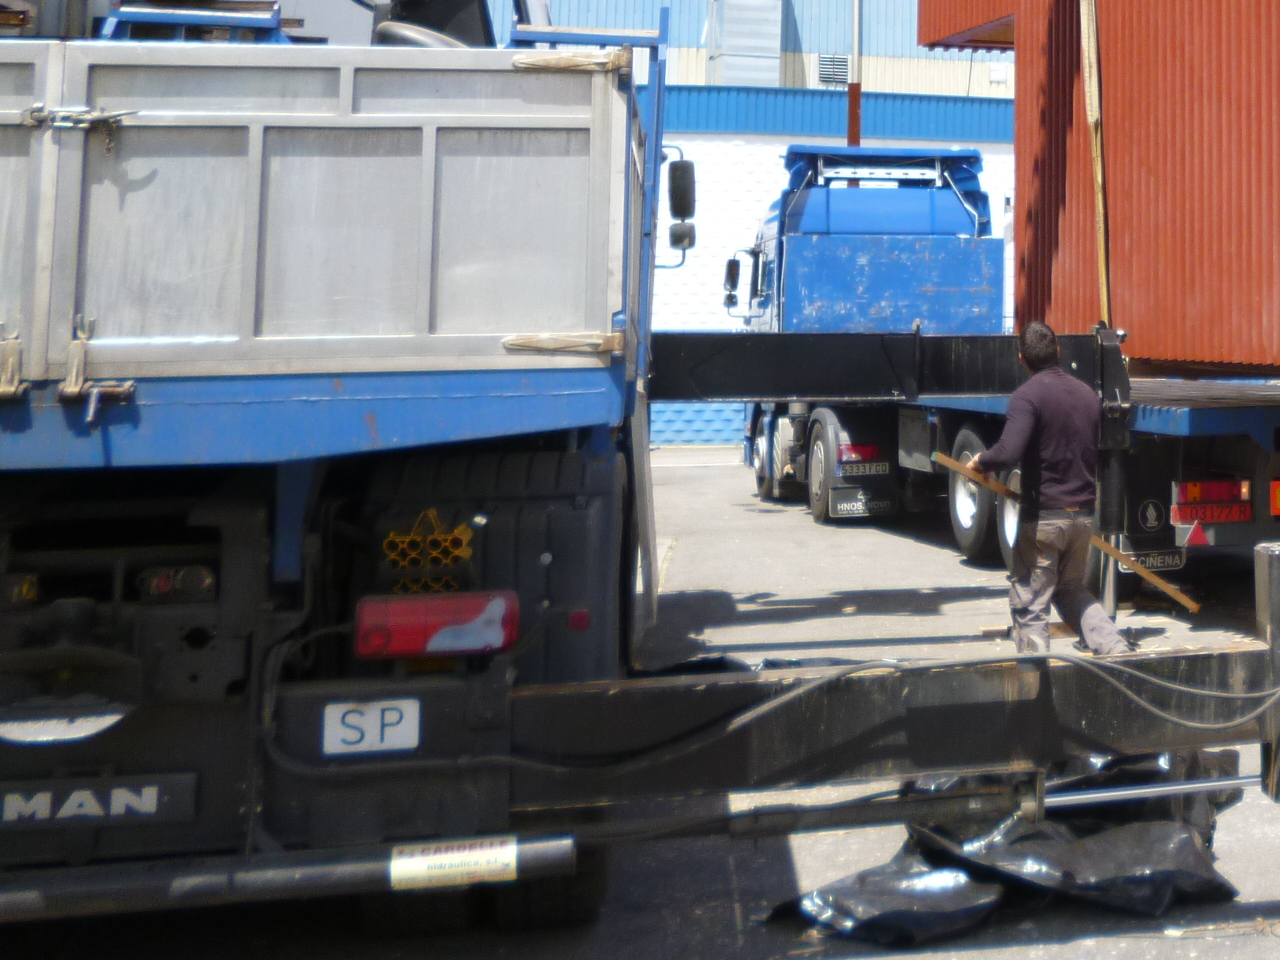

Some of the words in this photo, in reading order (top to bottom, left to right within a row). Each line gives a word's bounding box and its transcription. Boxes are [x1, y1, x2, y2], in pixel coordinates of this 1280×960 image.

[1122, 553, 1181, 569] CIÑENA
[339, 707, 405, 746] SP
[2, 785, 159, 822] MAN
